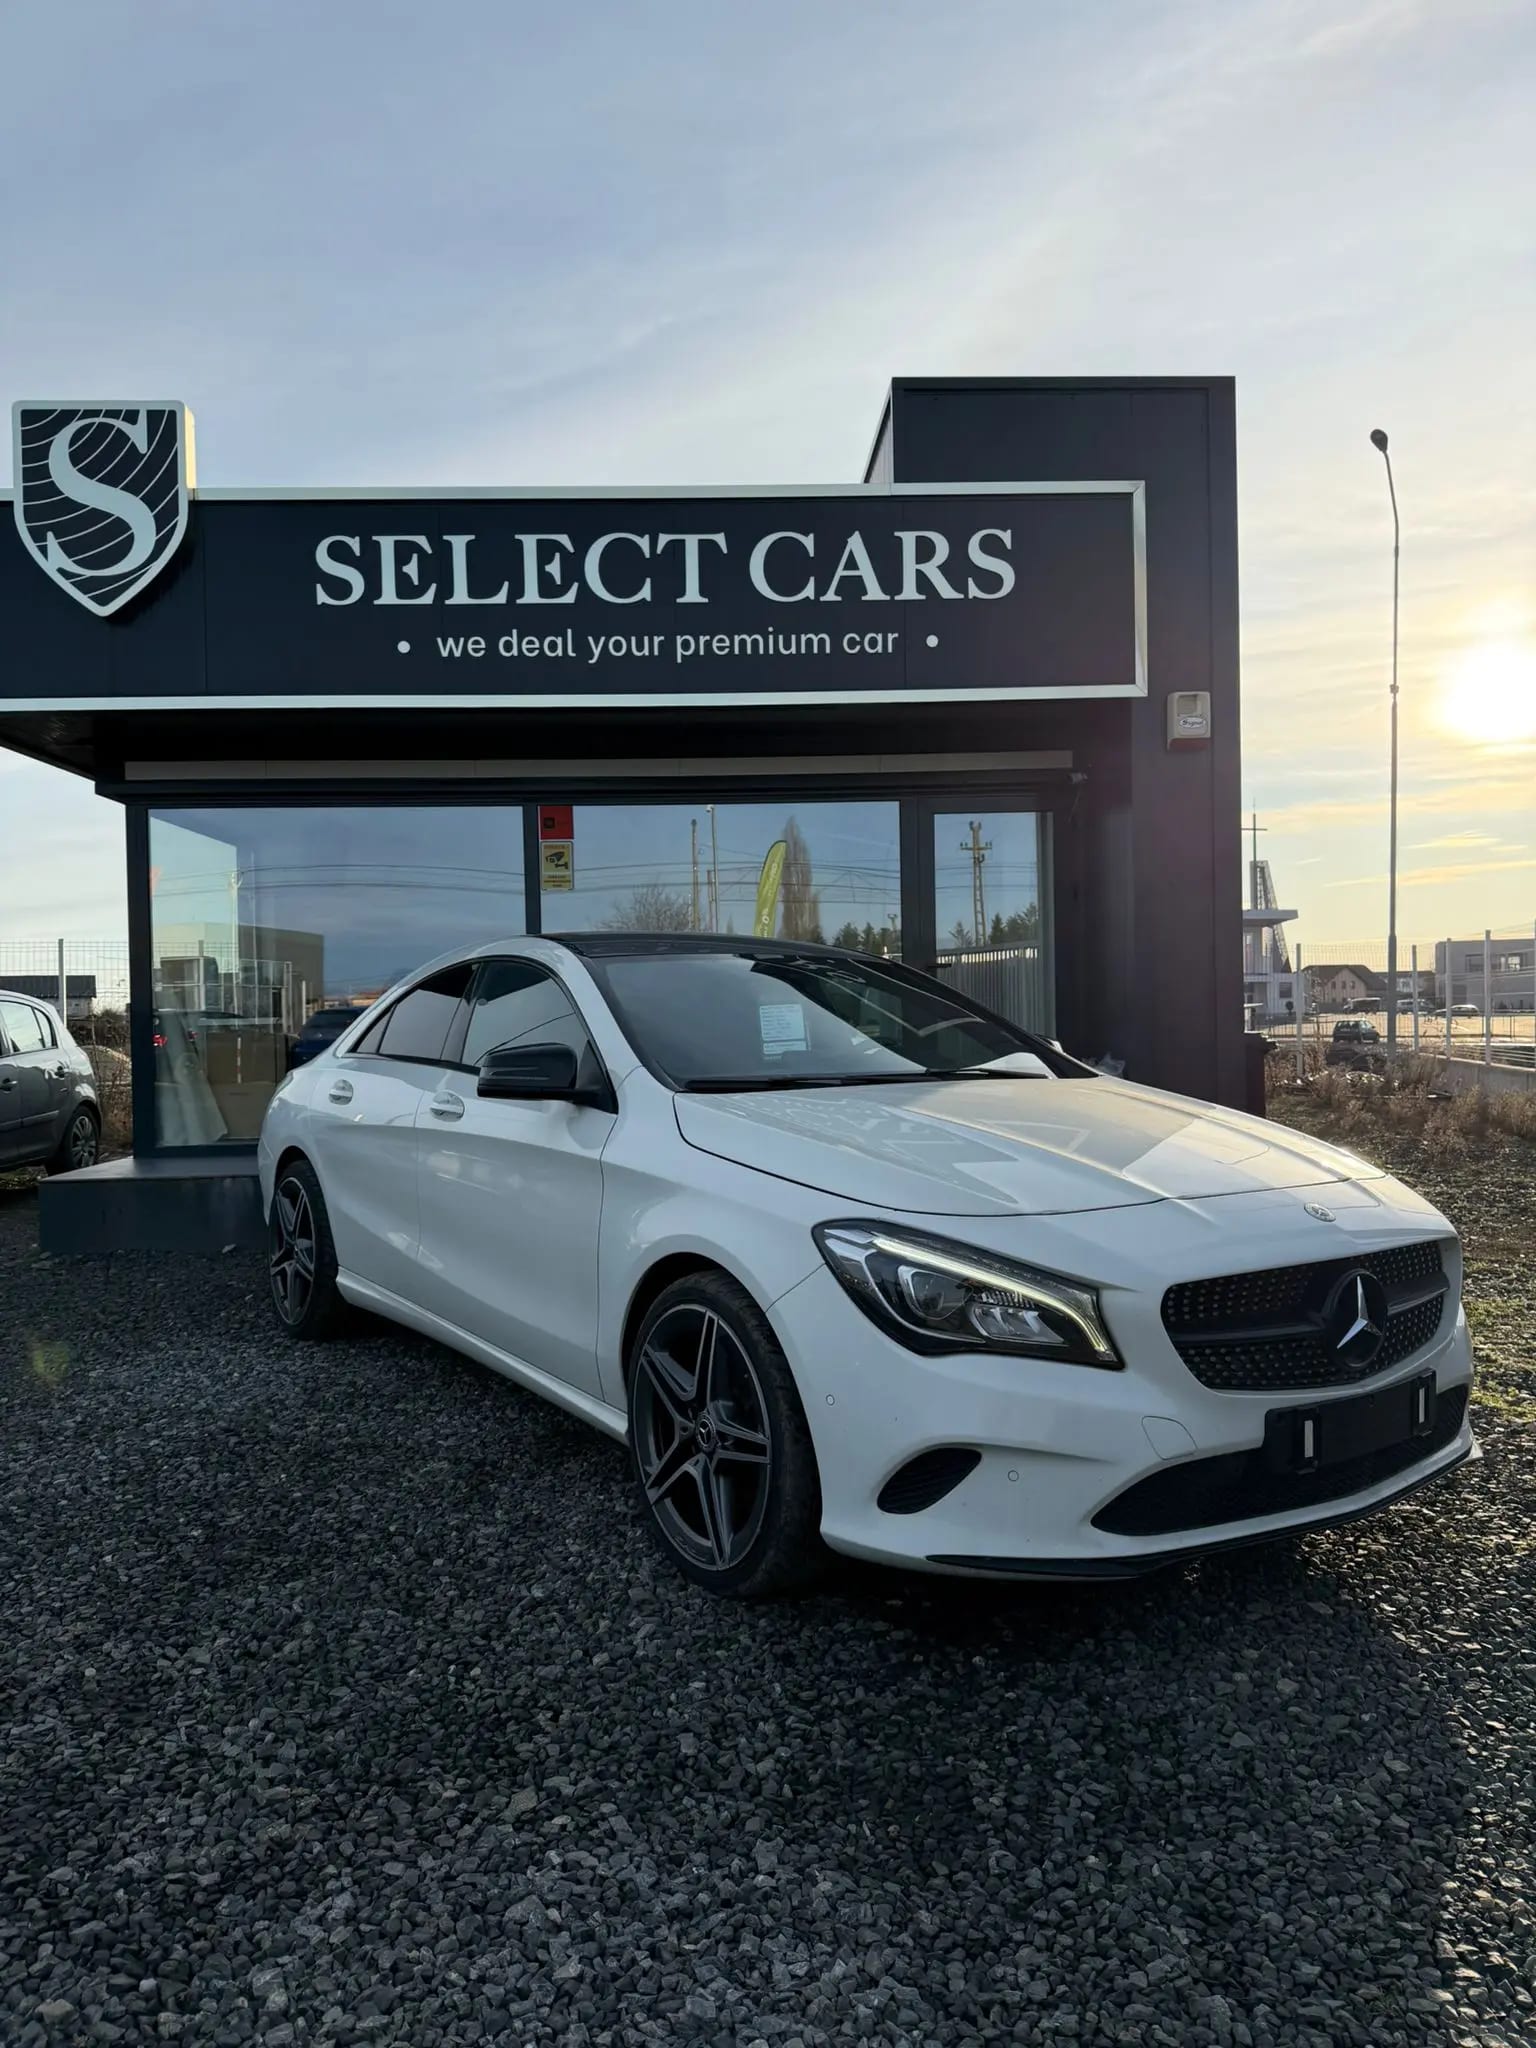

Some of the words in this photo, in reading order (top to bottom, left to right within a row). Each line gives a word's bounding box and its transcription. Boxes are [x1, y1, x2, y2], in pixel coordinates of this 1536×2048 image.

[46, 407, 157, 576] S
[315, 532, 728, 606] SELECT
[749, 528, 1016, 603] CARS
[436, 636, 486, 658] we
[498, 628, 577, 658] deal
[587, 635, 665, 664] your
[675, 626, 831, 664] premium
[842, 632, 899, 654] car
